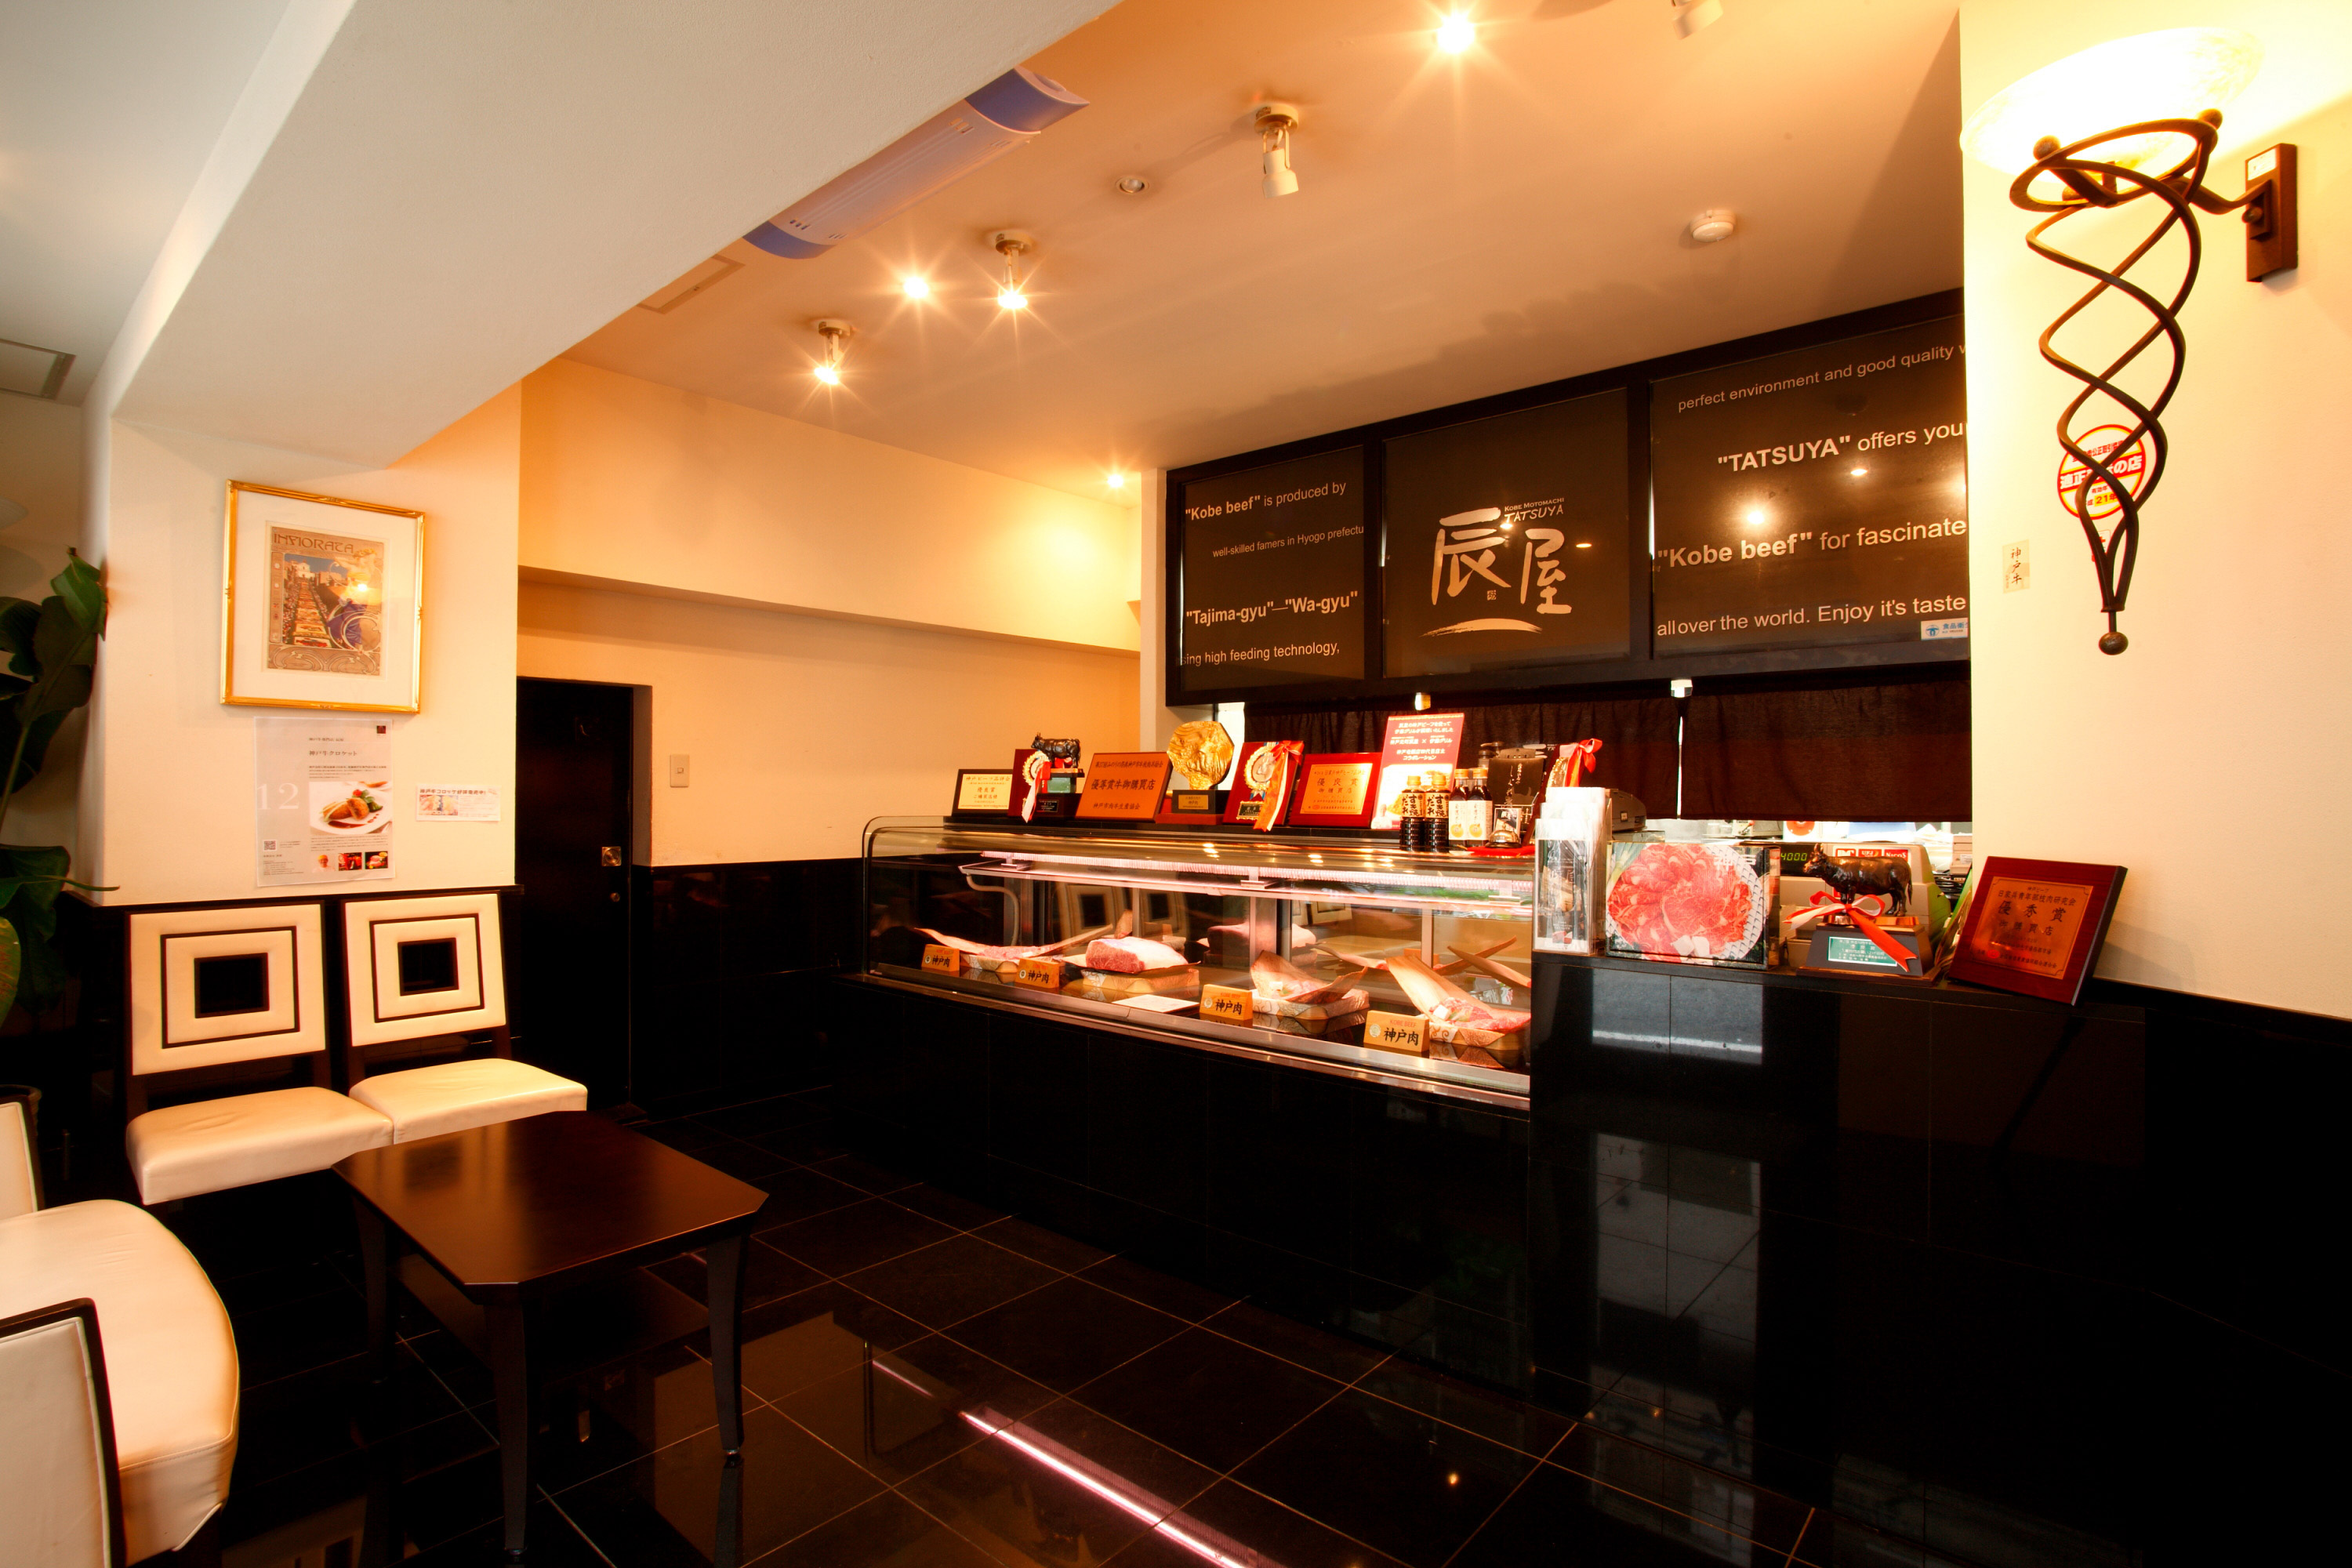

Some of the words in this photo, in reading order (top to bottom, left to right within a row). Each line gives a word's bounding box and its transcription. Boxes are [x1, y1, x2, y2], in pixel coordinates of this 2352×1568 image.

[1679, 390, 1725, 412] perfect
[1730, 372, 1820, 401] environment
[1824, 364, 1852, 380] and
[1857, 355, 1896, 378] good
[1900, 345, 1955, 368] quality
[1718, 435, 1850, 472] "TATSUYA"
[1857, 426, 1917, 451] offers
[1185, 503, 1222, 521] "Kobe
[1225, 494, 1261, 516] beef"
[1264, 495, 1273, 507] is
[1276, 483, 1328, 507] produced
[1332, 480, 1346, 496] by
[1504, 504, 1564, 523] TATSUYA
[1212, 540, 1255, 557] well-skilled
[1257, 537, 1286, 551] famers
[1287, 535, 1295, 546] in
[1297, 530, 1326, 547] Hyogo
[1327, 524, 1364, 542] prefectu
[1657, 543, 1733, 568] "Kobe
[1740, 532, 1812, 560] beef"
[1819, 530, 1851, 550] for
[1857, 517, 1967, 546] fascinate
[1431, 506, 1573, 615] 辰屋
[1720, 615, 1748, 630] the
[1754, 608, 1810, 627] world.
[1817, 603, 1874, 625] Enjoy
[1880, 599, 1907, 617] it's
[1912, 594, 1966, 615] taste
[1205, 650, 1227, 666] high
[1230, 646, 1271, 662] feeding
[1274, 641, 1340, 658] technology,
[257, 782, 299, 811] 12
[1780, 852, 1808, 862] 4000
[932, 956, 950, 967] 神戸肉
[1028, 970, 1050, 984] 神戸肉
[1215, 999, 1243, 1015] 神戸肉
[1384, 1027, 1419, 1046] 神戸肉
